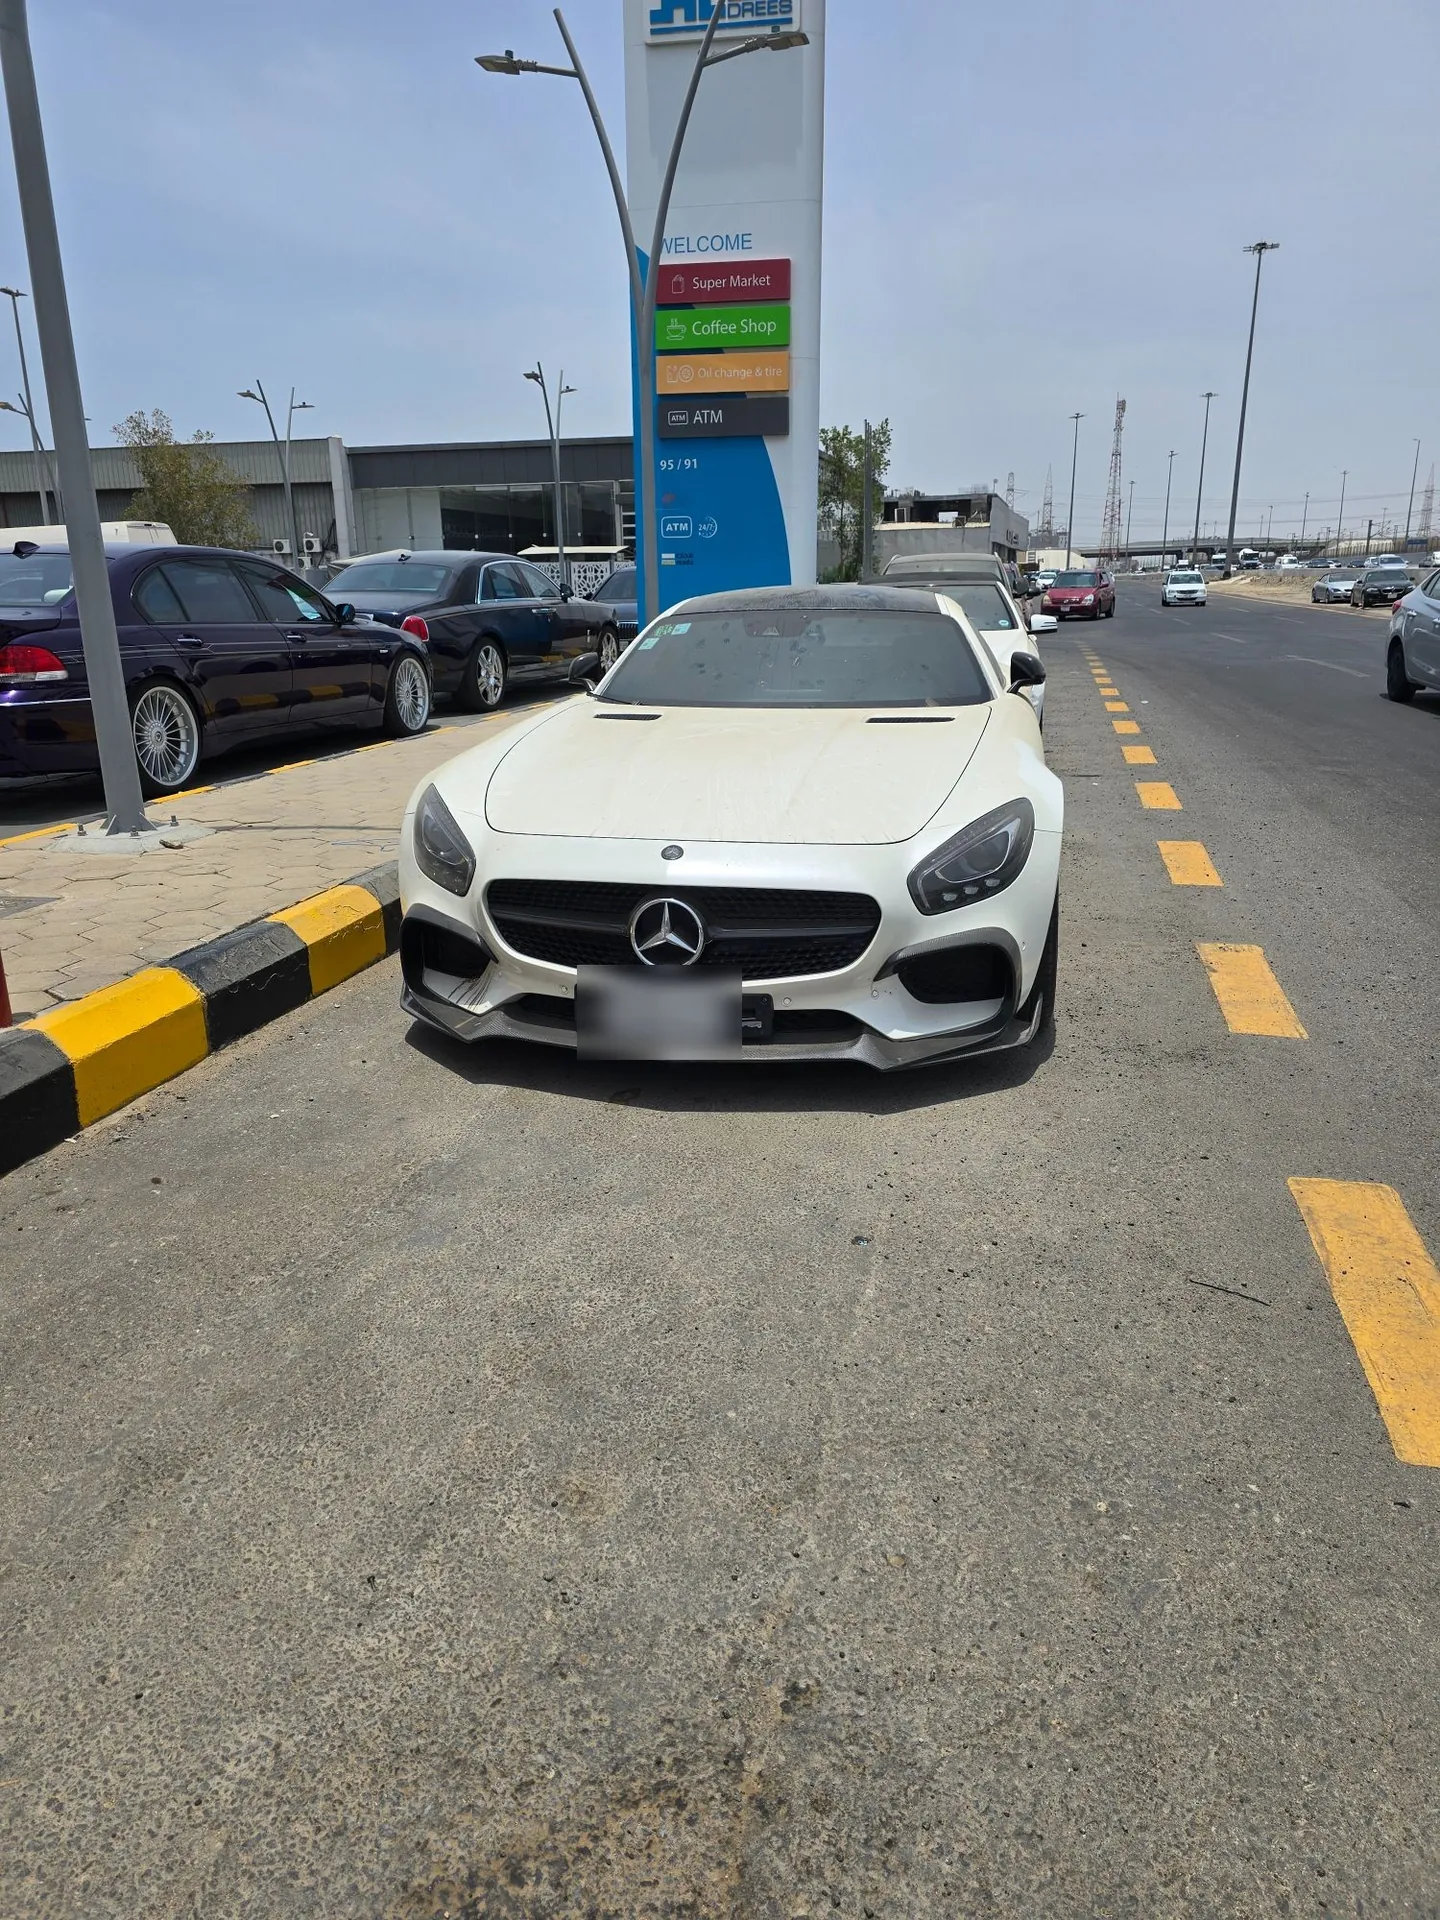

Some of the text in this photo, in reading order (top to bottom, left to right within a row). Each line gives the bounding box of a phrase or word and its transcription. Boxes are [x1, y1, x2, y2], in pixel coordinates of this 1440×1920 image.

[662, 233, 752, 254] WELCOME
[692, 274, 771, 291] Super Market
[692, 319, 777, 335] Coffee Shop
[698, 366, 782, 380] Oil change & tire
[693, 409, 723, 424] ATM
[660, 459, 674, 470] 95
[684, 458, 697, 469] 91
[665, 522, 689, 531] ATM
[698, 523, 713, 531] 24/7
